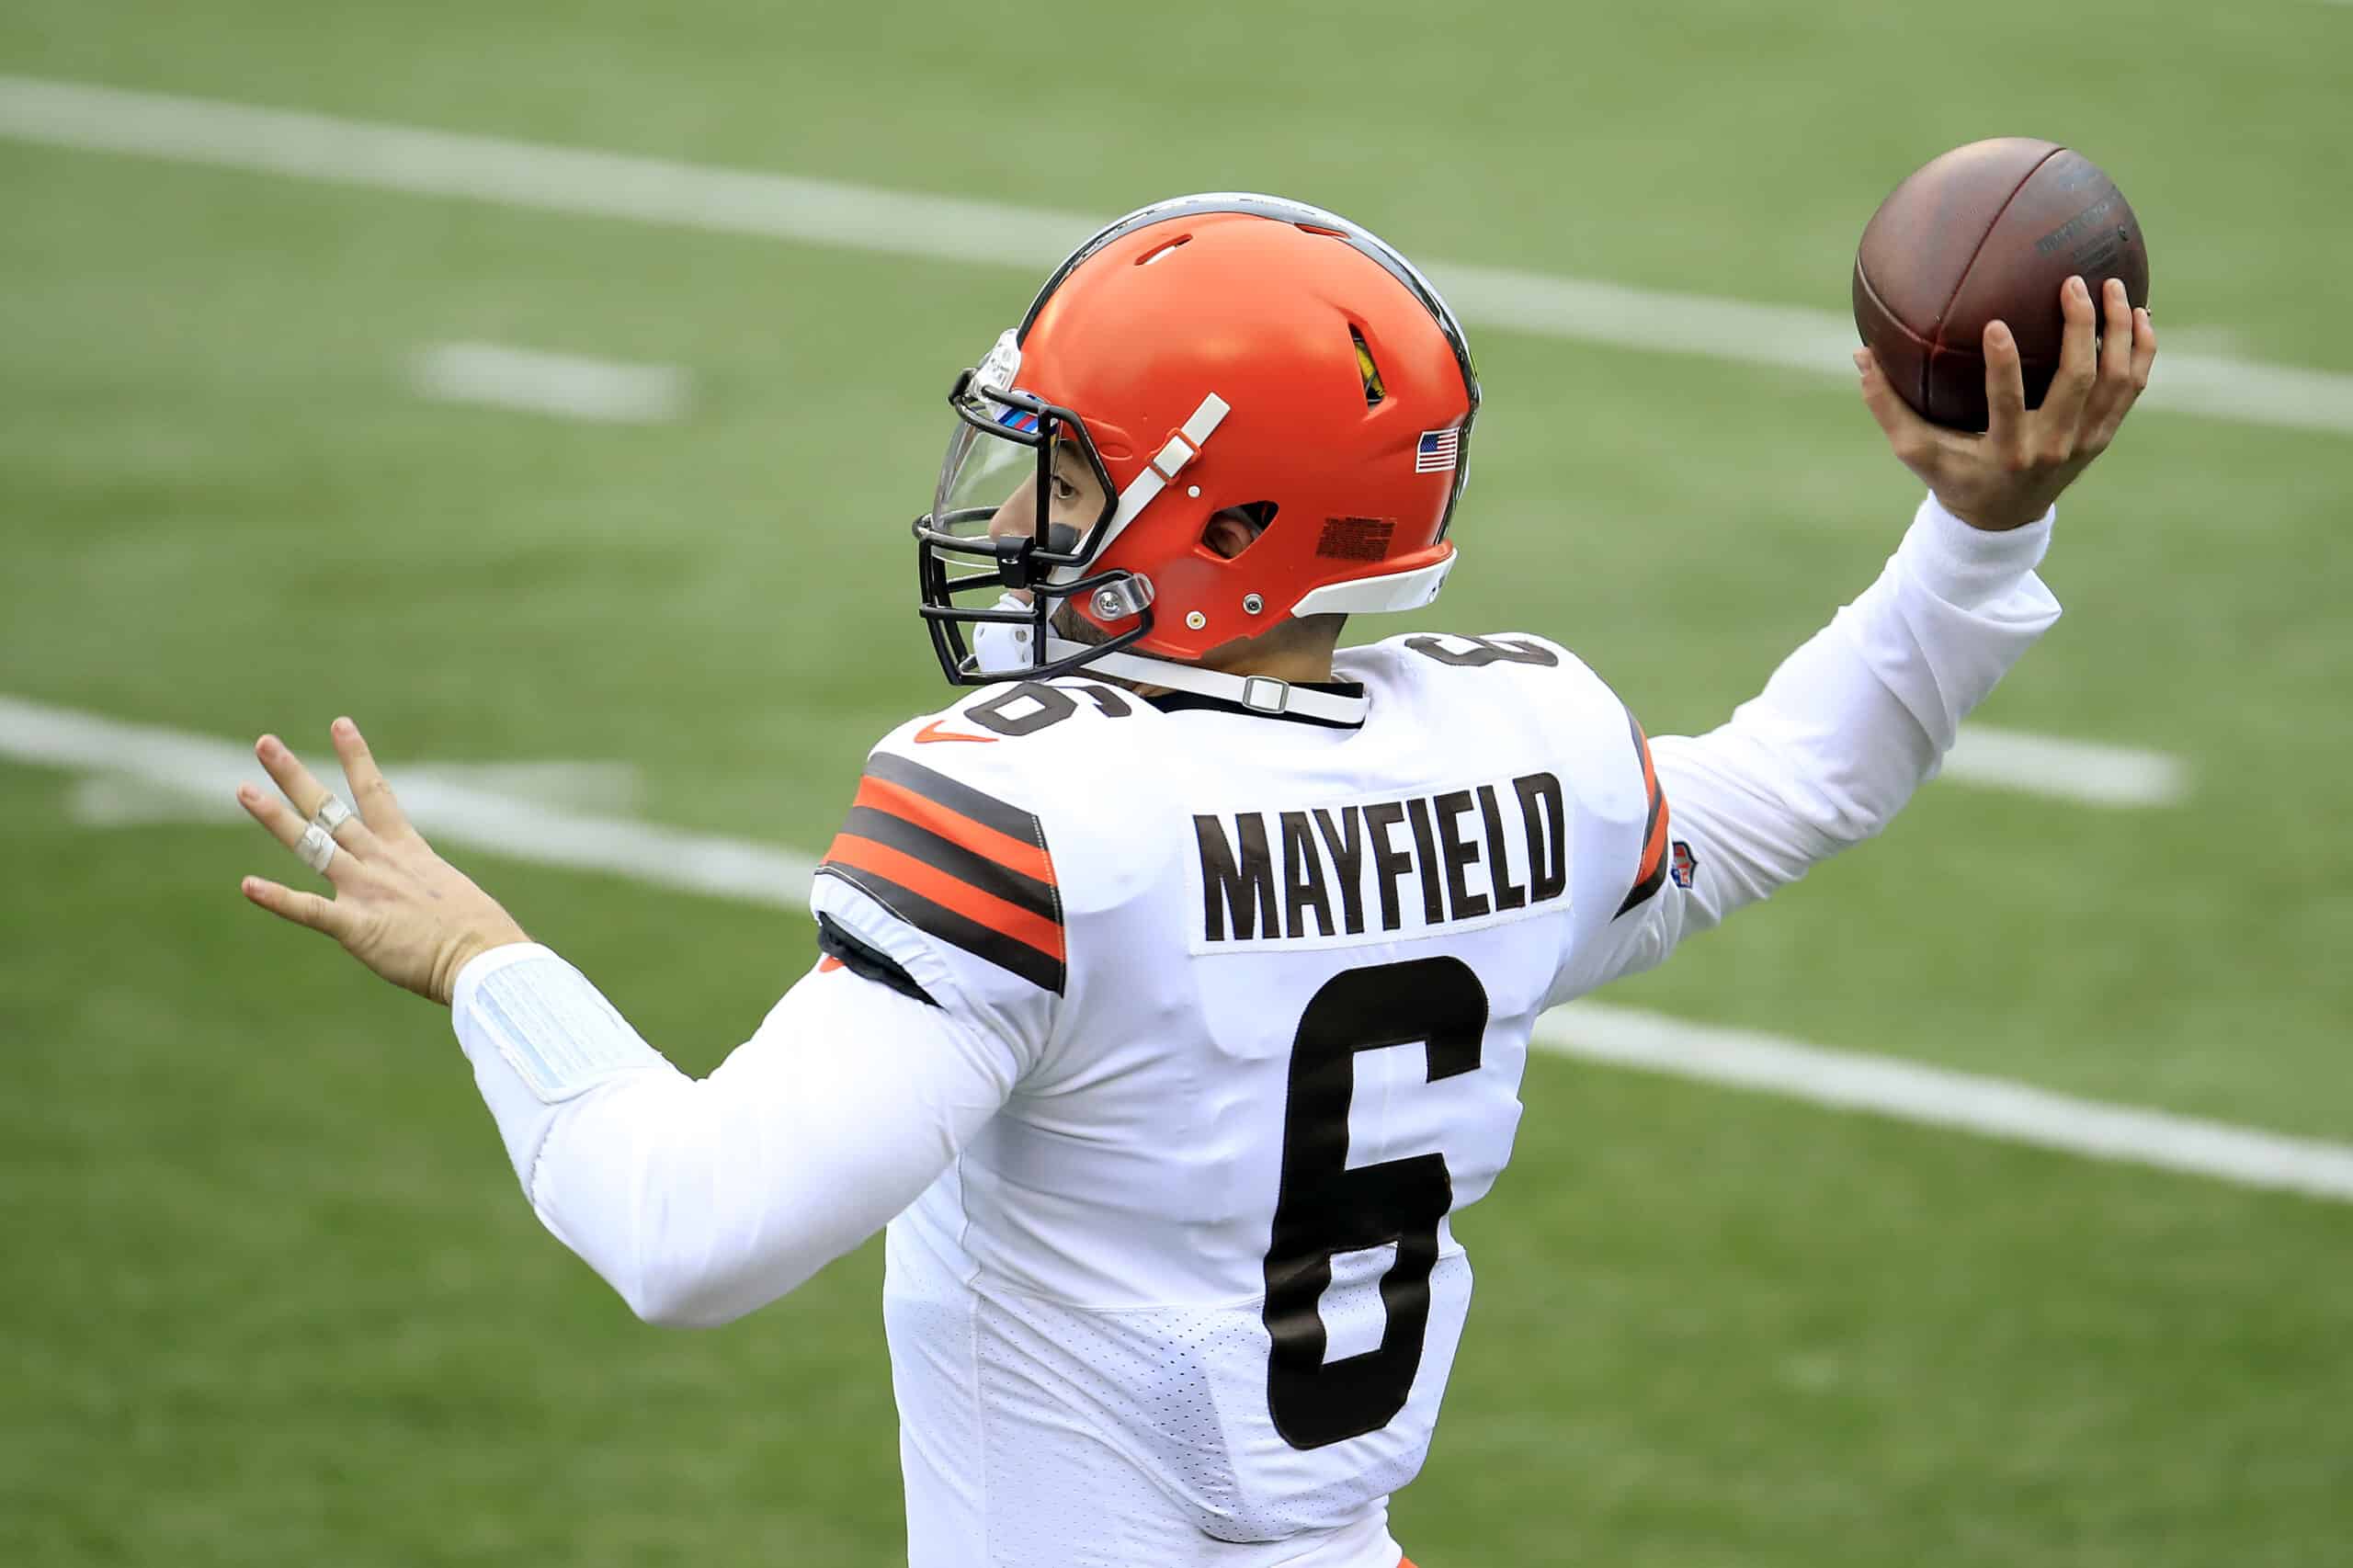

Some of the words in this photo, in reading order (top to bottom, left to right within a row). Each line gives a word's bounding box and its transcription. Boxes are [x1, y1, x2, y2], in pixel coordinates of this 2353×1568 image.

[963, 681, 1131, 736] 6
[1192, 772, 1566, 941] MAYFIELD
[1262, 955, 1489, 1450] 6
